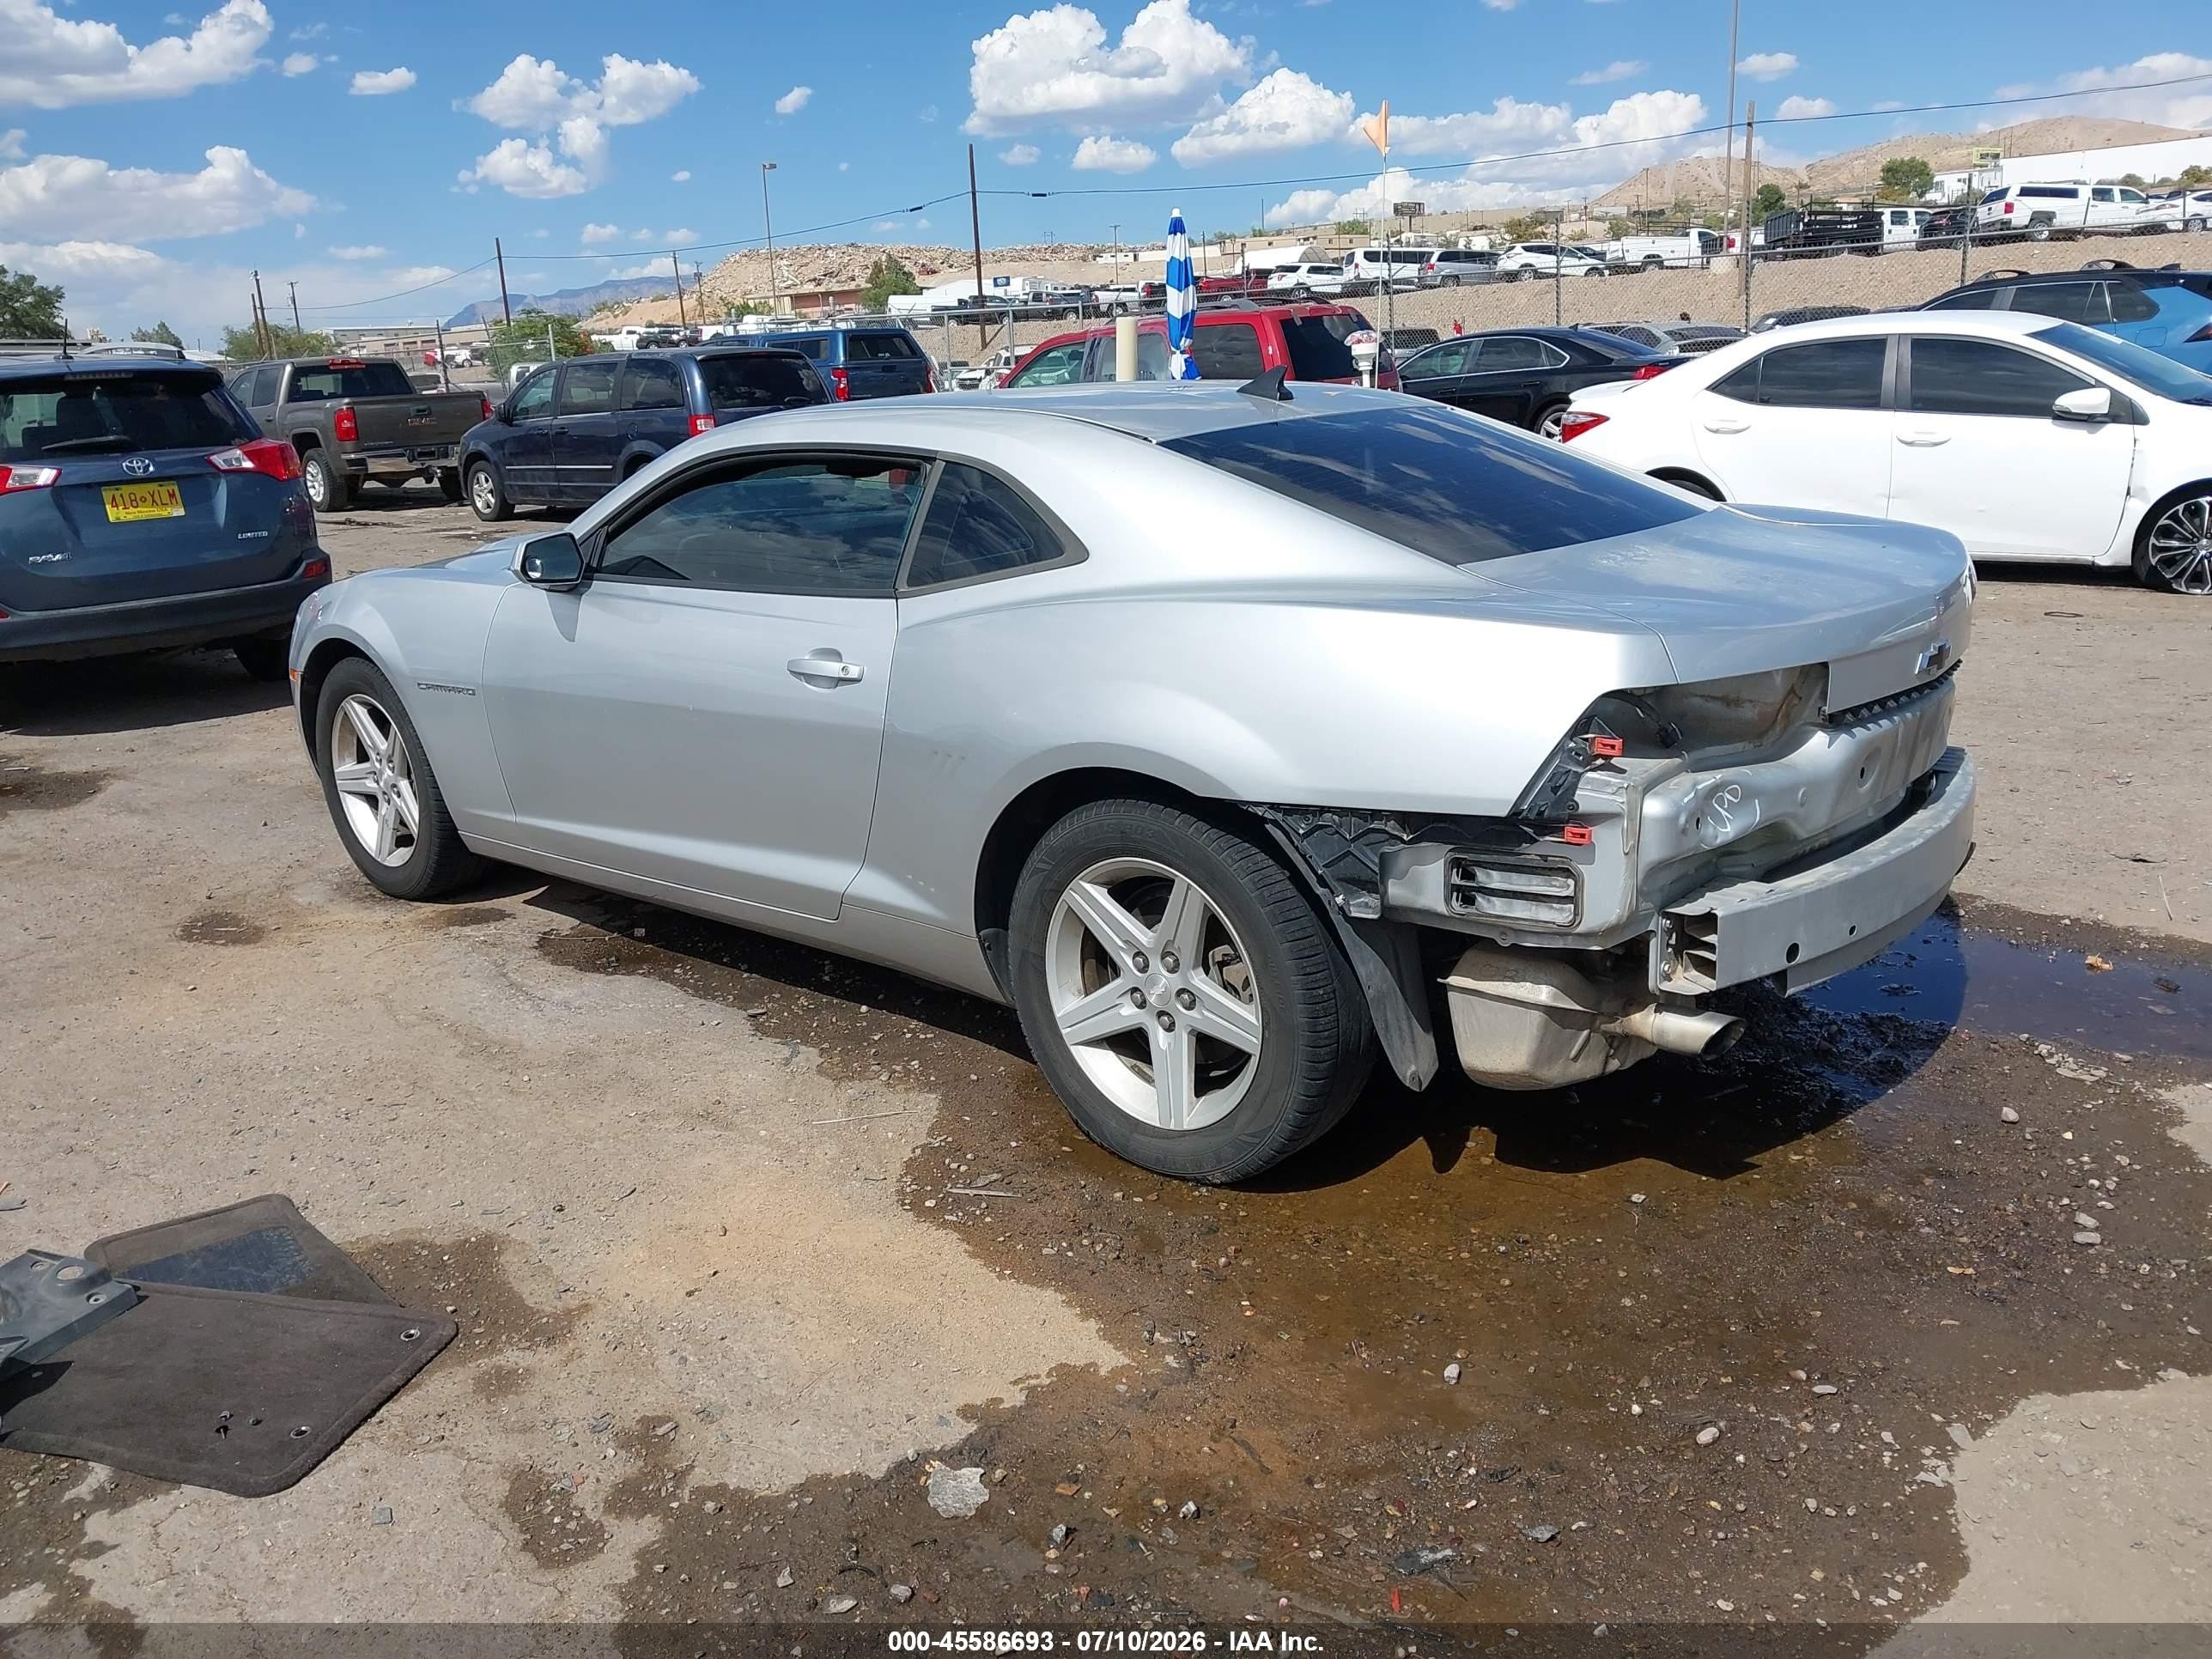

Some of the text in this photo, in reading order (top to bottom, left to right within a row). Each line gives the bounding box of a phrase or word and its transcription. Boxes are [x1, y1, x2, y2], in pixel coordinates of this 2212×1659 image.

[111, 488, 179, 510] 418 XLM
[238, 531, 268, 539] LIMITED
[28, 552, 72, 564] RAV4
[417, 682, 476, 696] CAMARO
